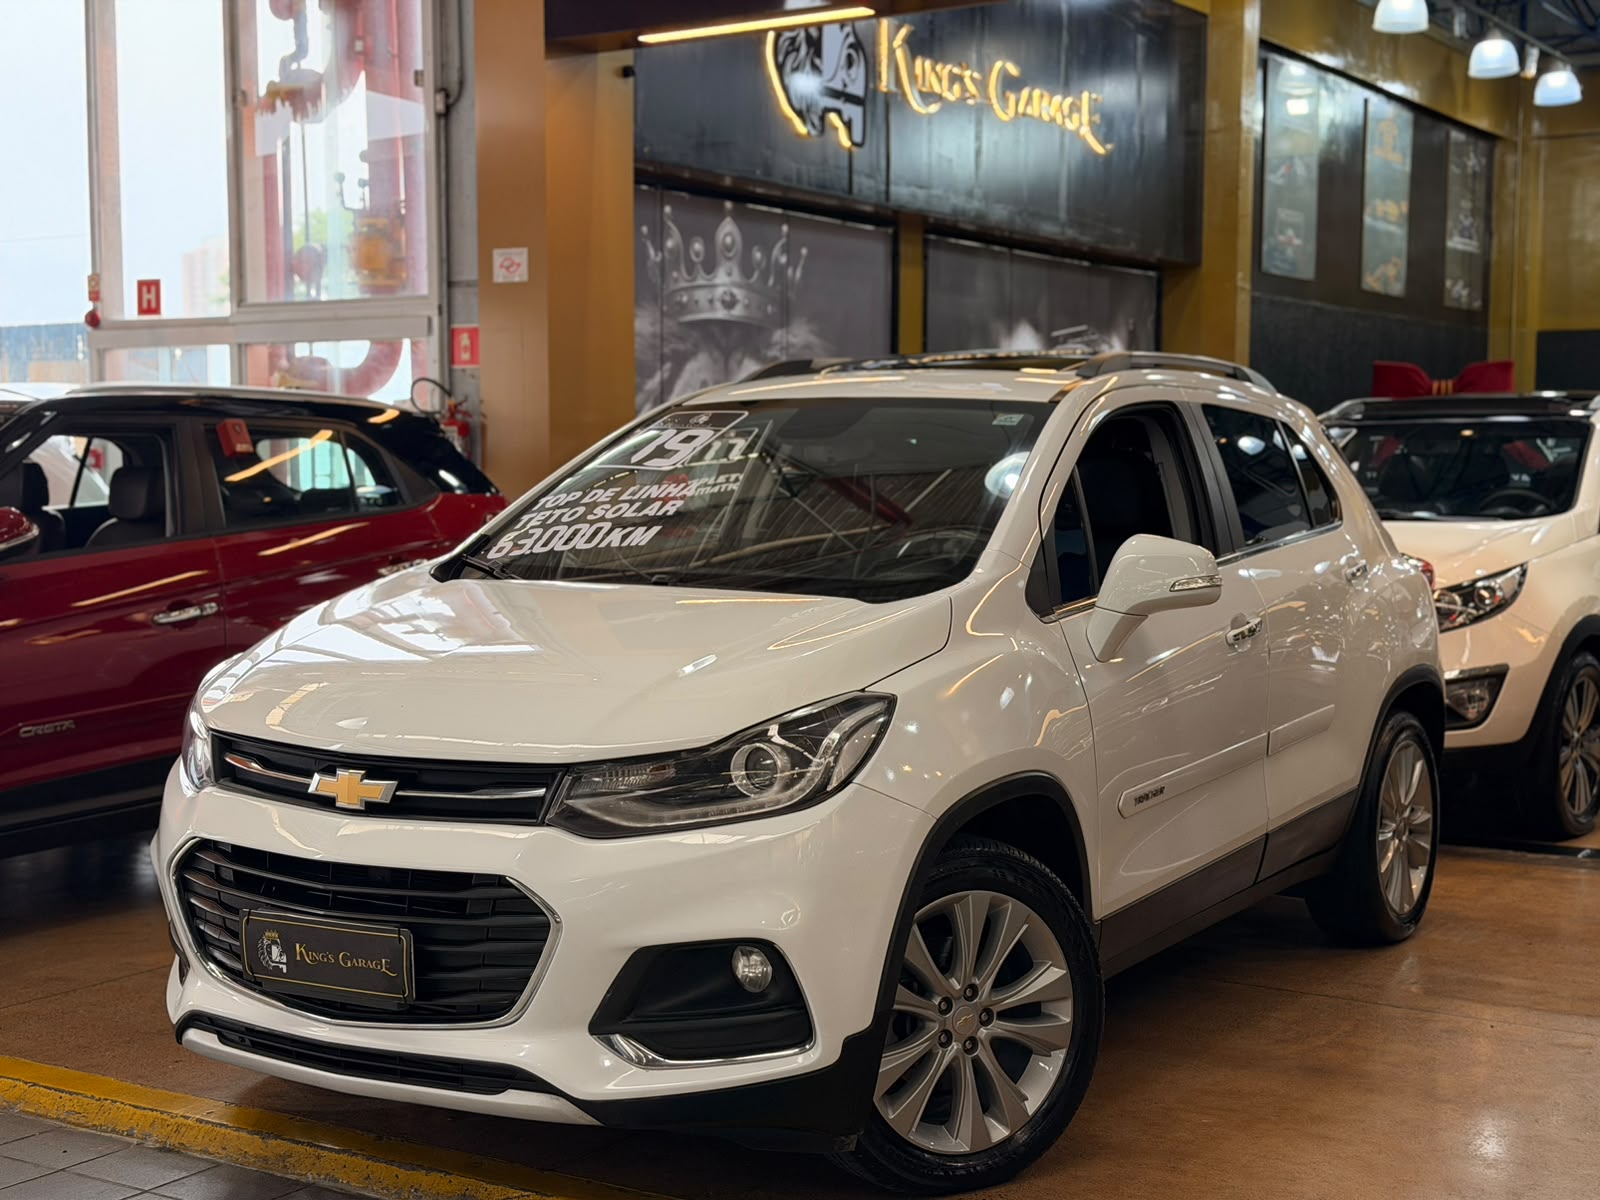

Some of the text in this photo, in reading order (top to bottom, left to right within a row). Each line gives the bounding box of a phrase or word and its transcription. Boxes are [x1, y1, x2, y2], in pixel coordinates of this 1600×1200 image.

[142, 284, 157, 310] H
[631, 429, 715, 466] 19
[532, 480, 697, 510] TOP DE LINHA
[514, 499, 684, 530] TETO SOLAR
[295, 943, 398, 977] KING'S GARAGE
